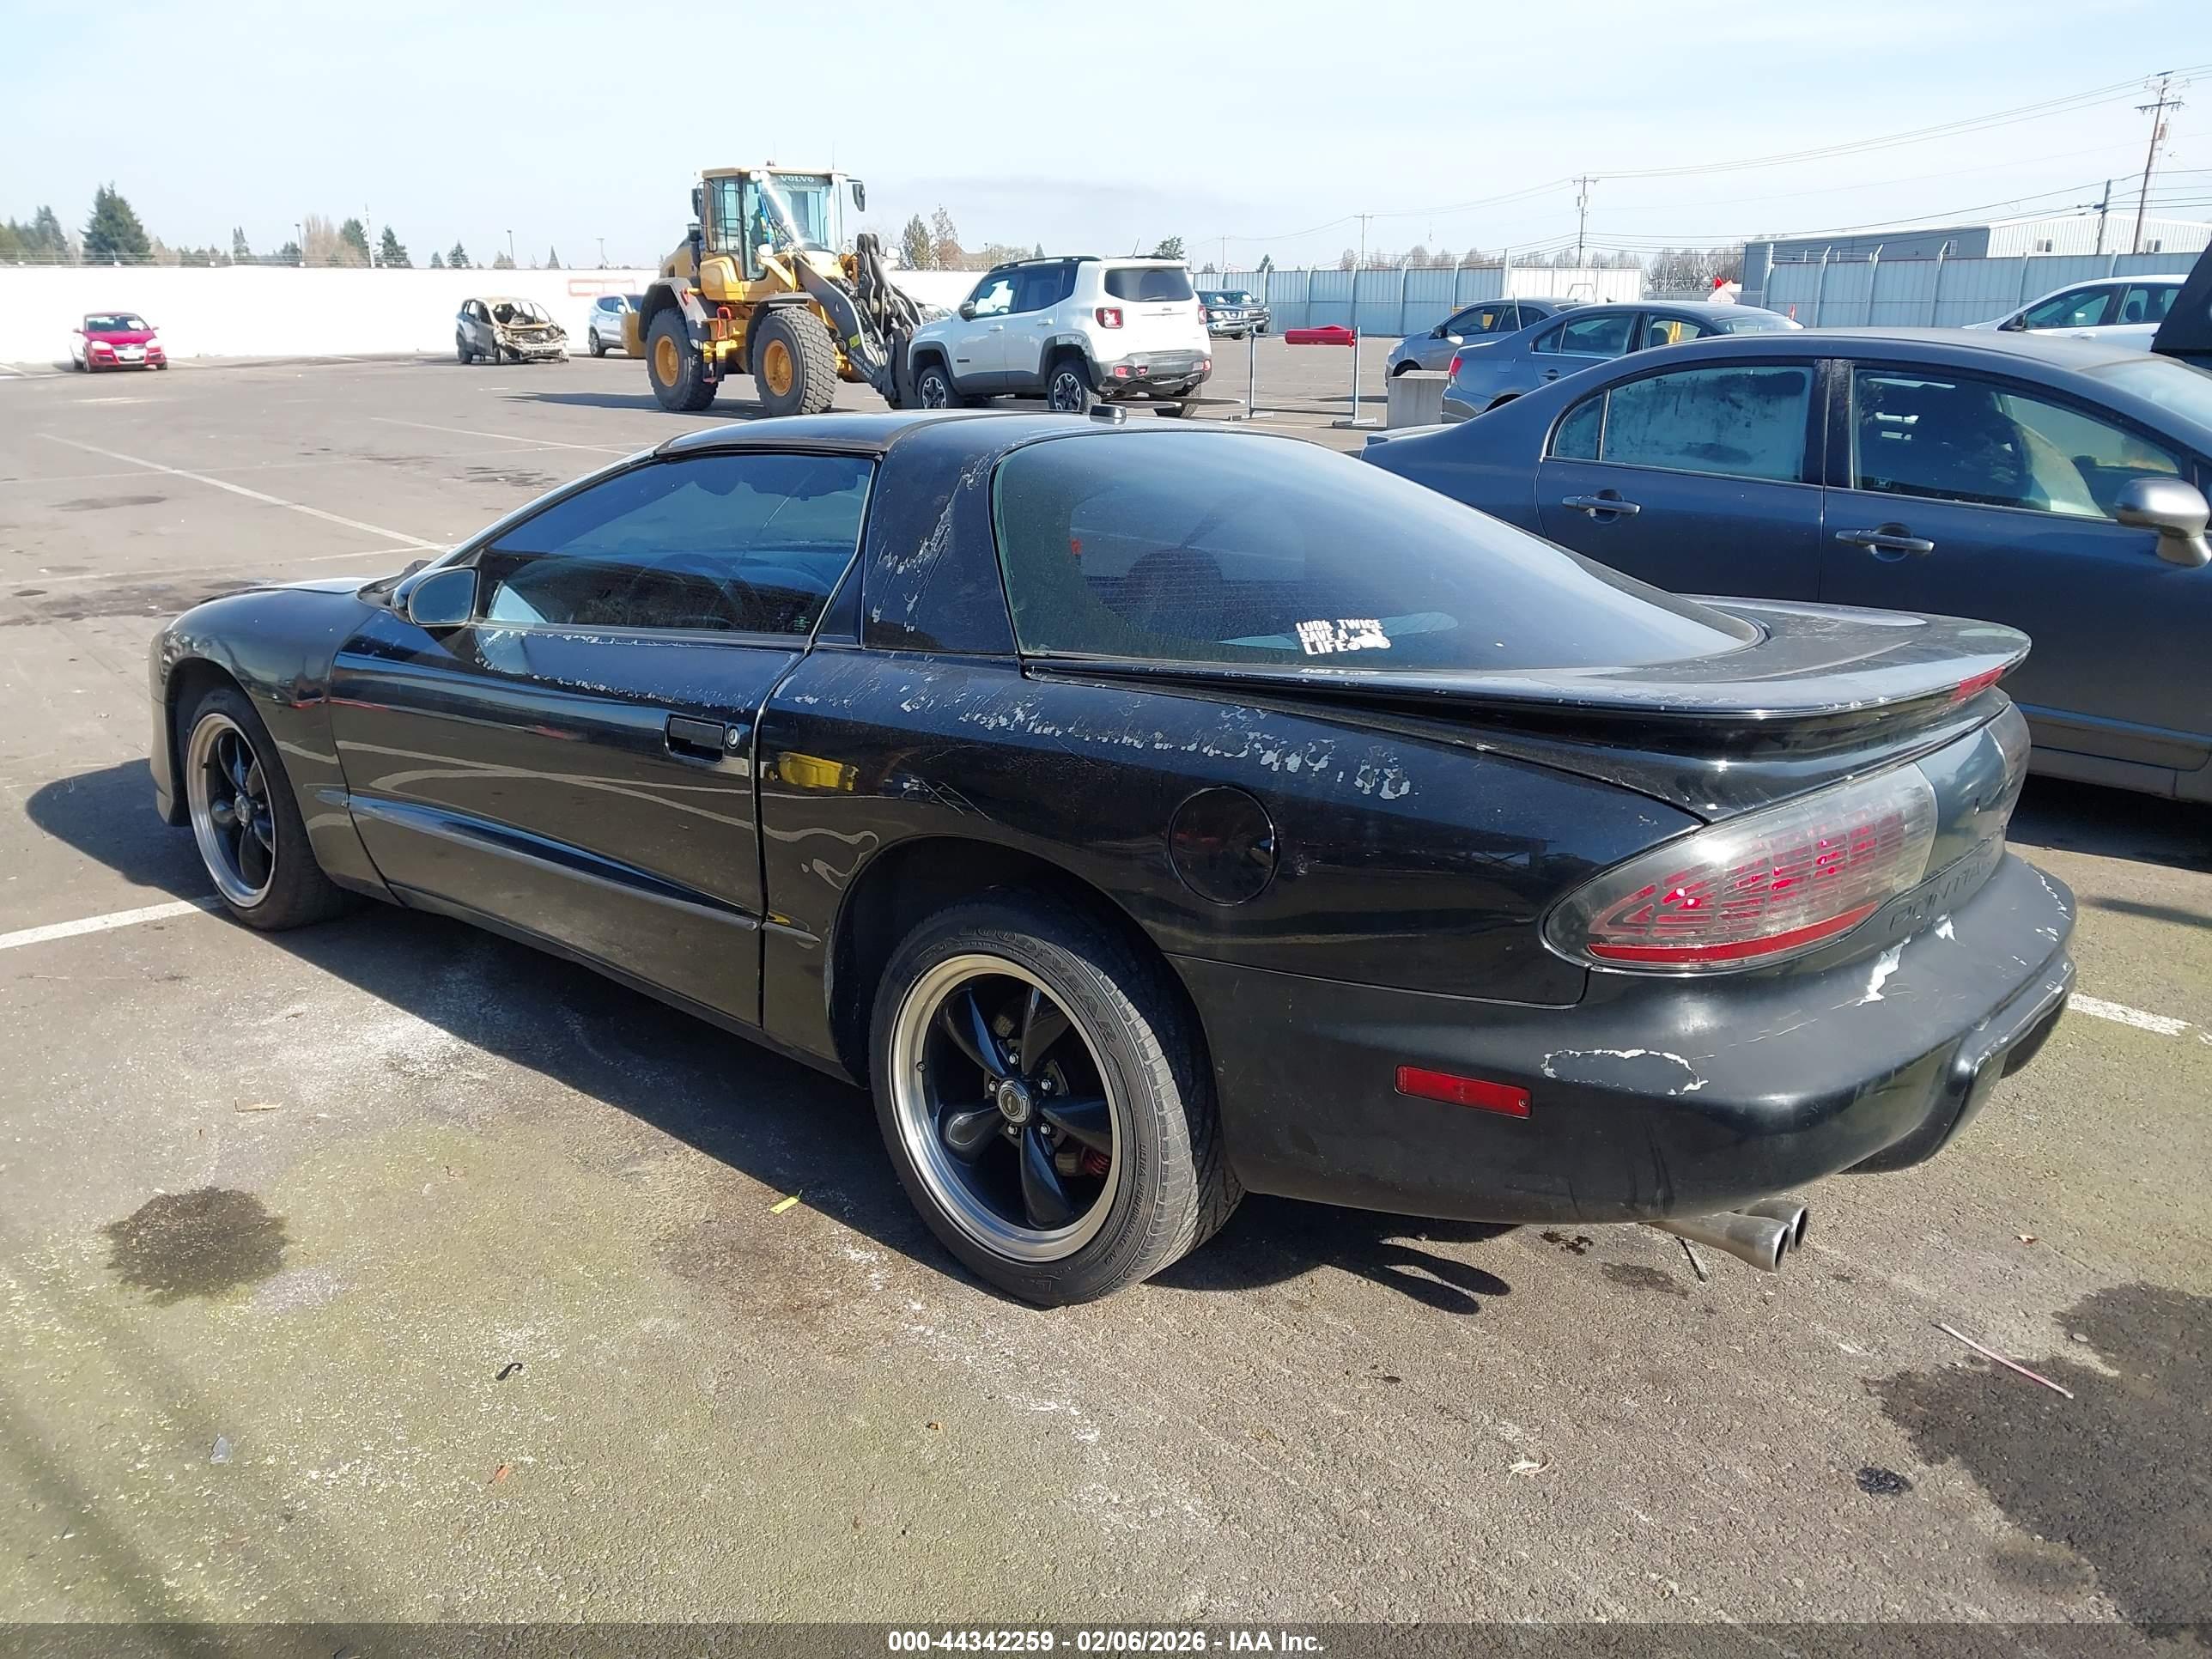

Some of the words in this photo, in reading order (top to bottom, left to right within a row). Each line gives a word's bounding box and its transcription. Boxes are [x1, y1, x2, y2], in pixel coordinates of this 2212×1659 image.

[1337, 618, 1383, 629] TWICE
[1299, 629, 1334, 642] SAVE
[1337, 629, 1349, 640] A
[1303, 639, 1348, 655] LIFE
[1138, 1143, 1148, 1176] ULTRA
[1117, 1183, 1147, 1250] PERFORMANCE
